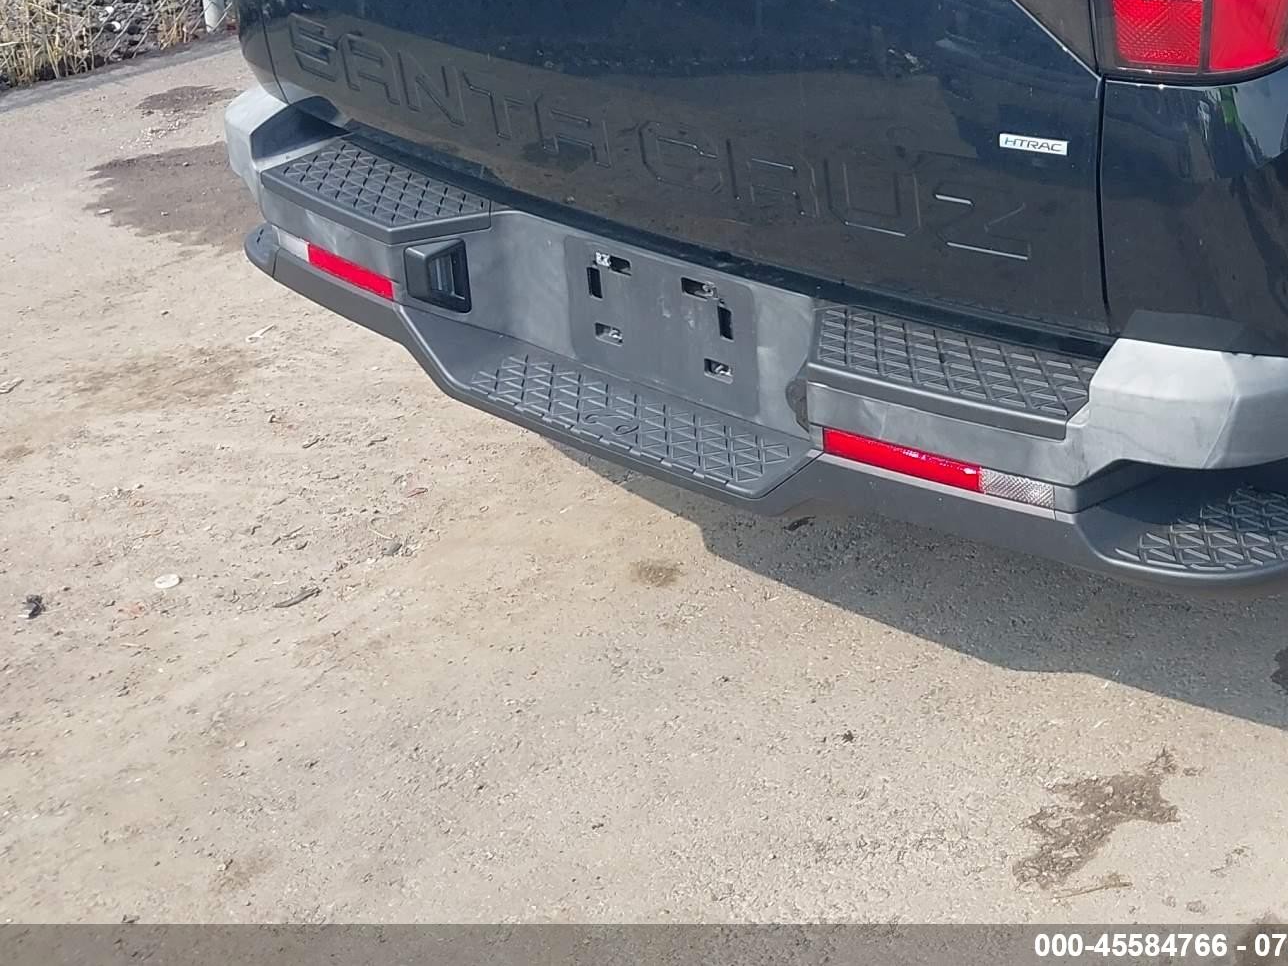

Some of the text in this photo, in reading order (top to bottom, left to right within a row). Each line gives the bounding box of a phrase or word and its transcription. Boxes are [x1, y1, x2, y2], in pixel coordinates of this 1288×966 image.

[288, 11, 1032, 262] SANTA CRUZ
[1004, 136, 1063, 152] HTRAC
